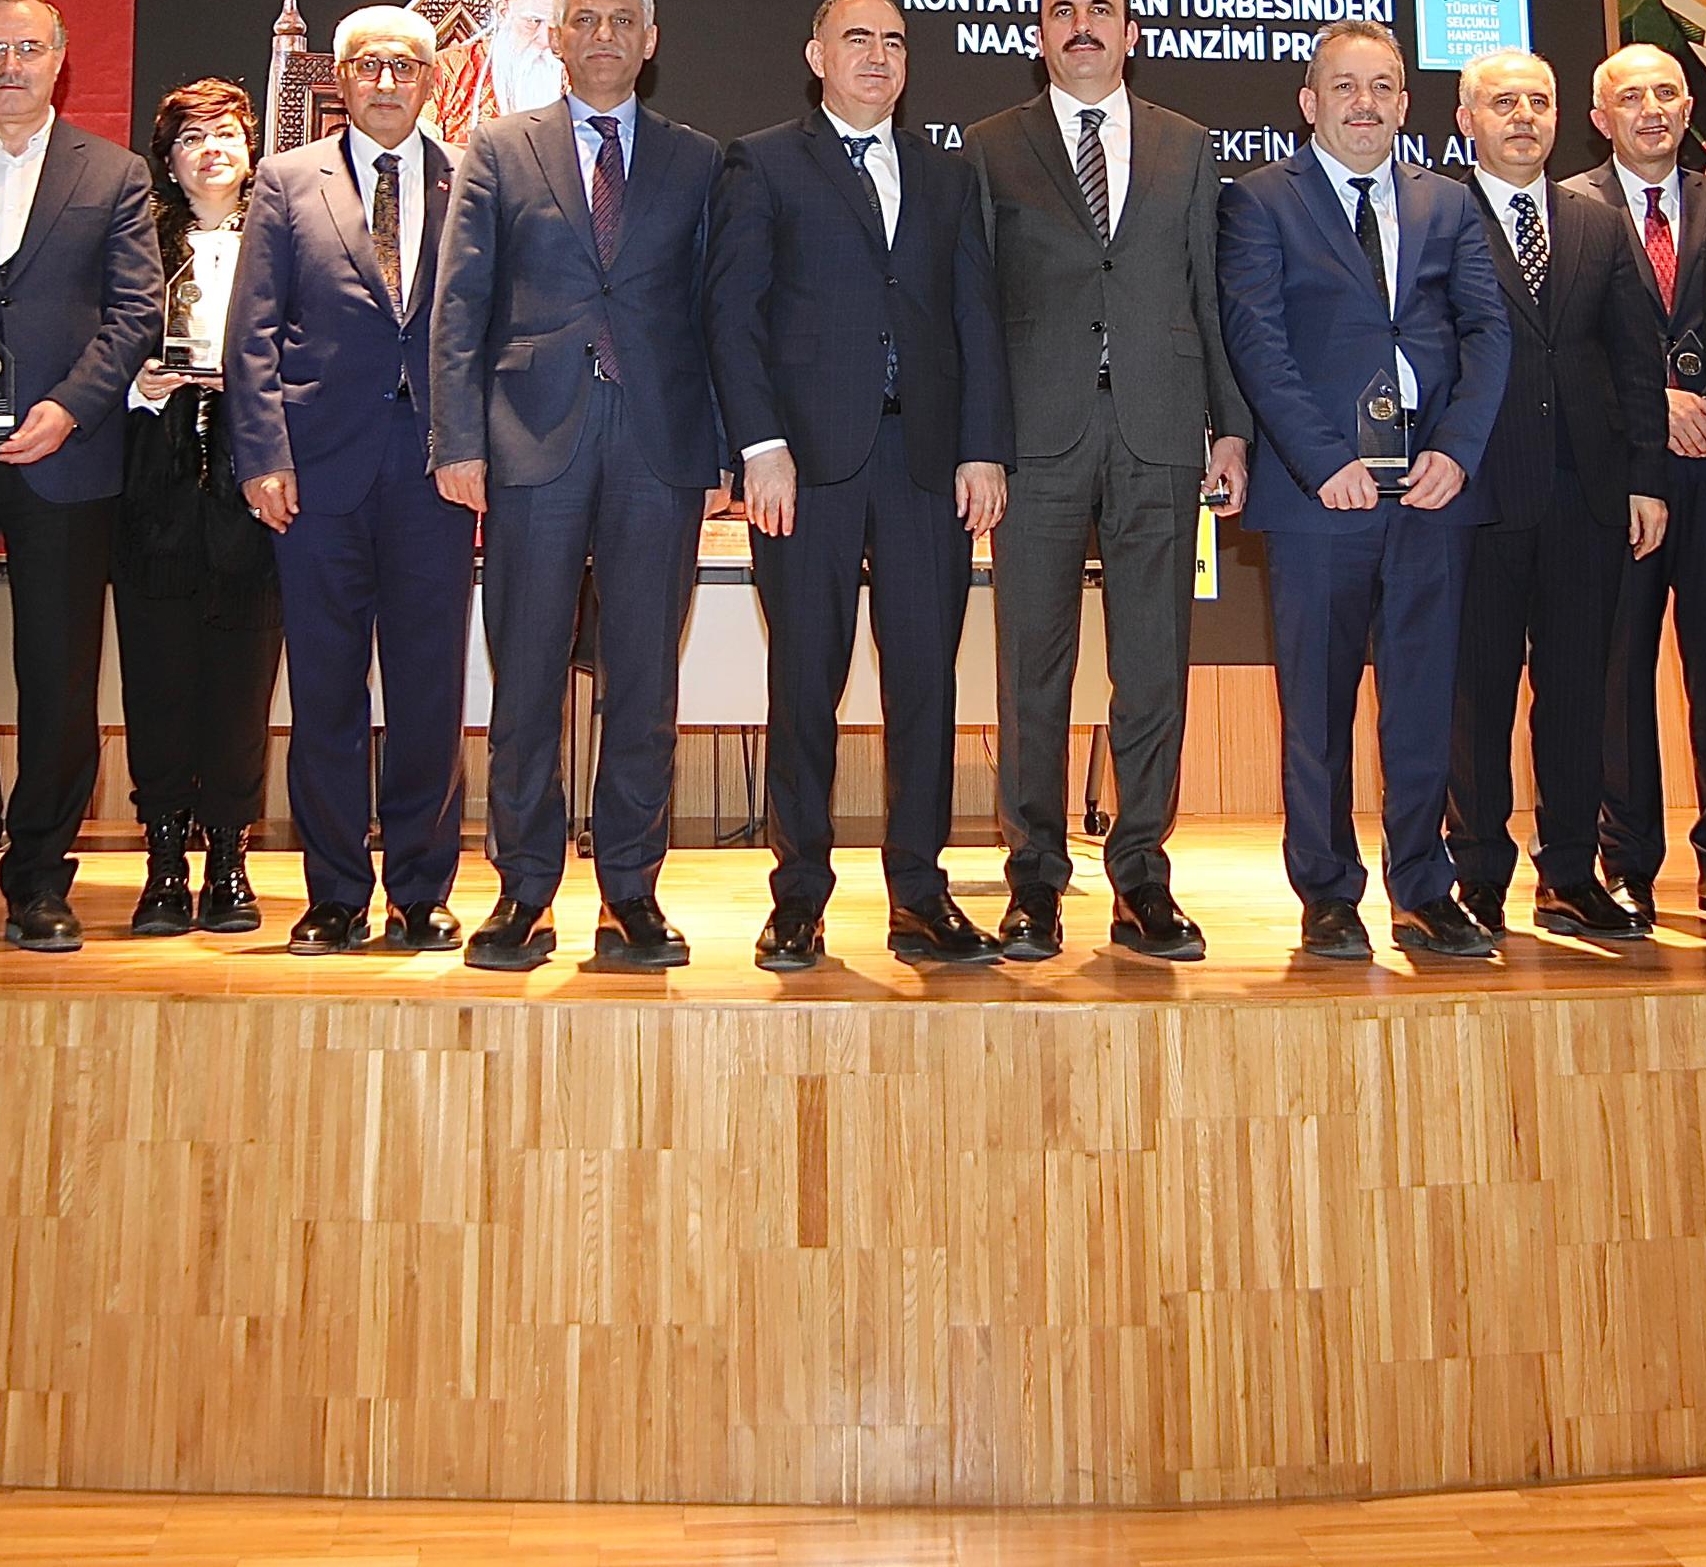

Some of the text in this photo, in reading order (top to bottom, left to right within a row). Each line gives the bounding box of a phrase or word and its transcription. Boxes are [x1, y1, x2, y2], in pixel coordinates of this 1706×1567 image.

[1445, 1, 1498, 16] TÜRKİYE
[1140, 24, 1265, 61] TANZİMİ
[1447, 30, 1500, 42] HANEDAN
